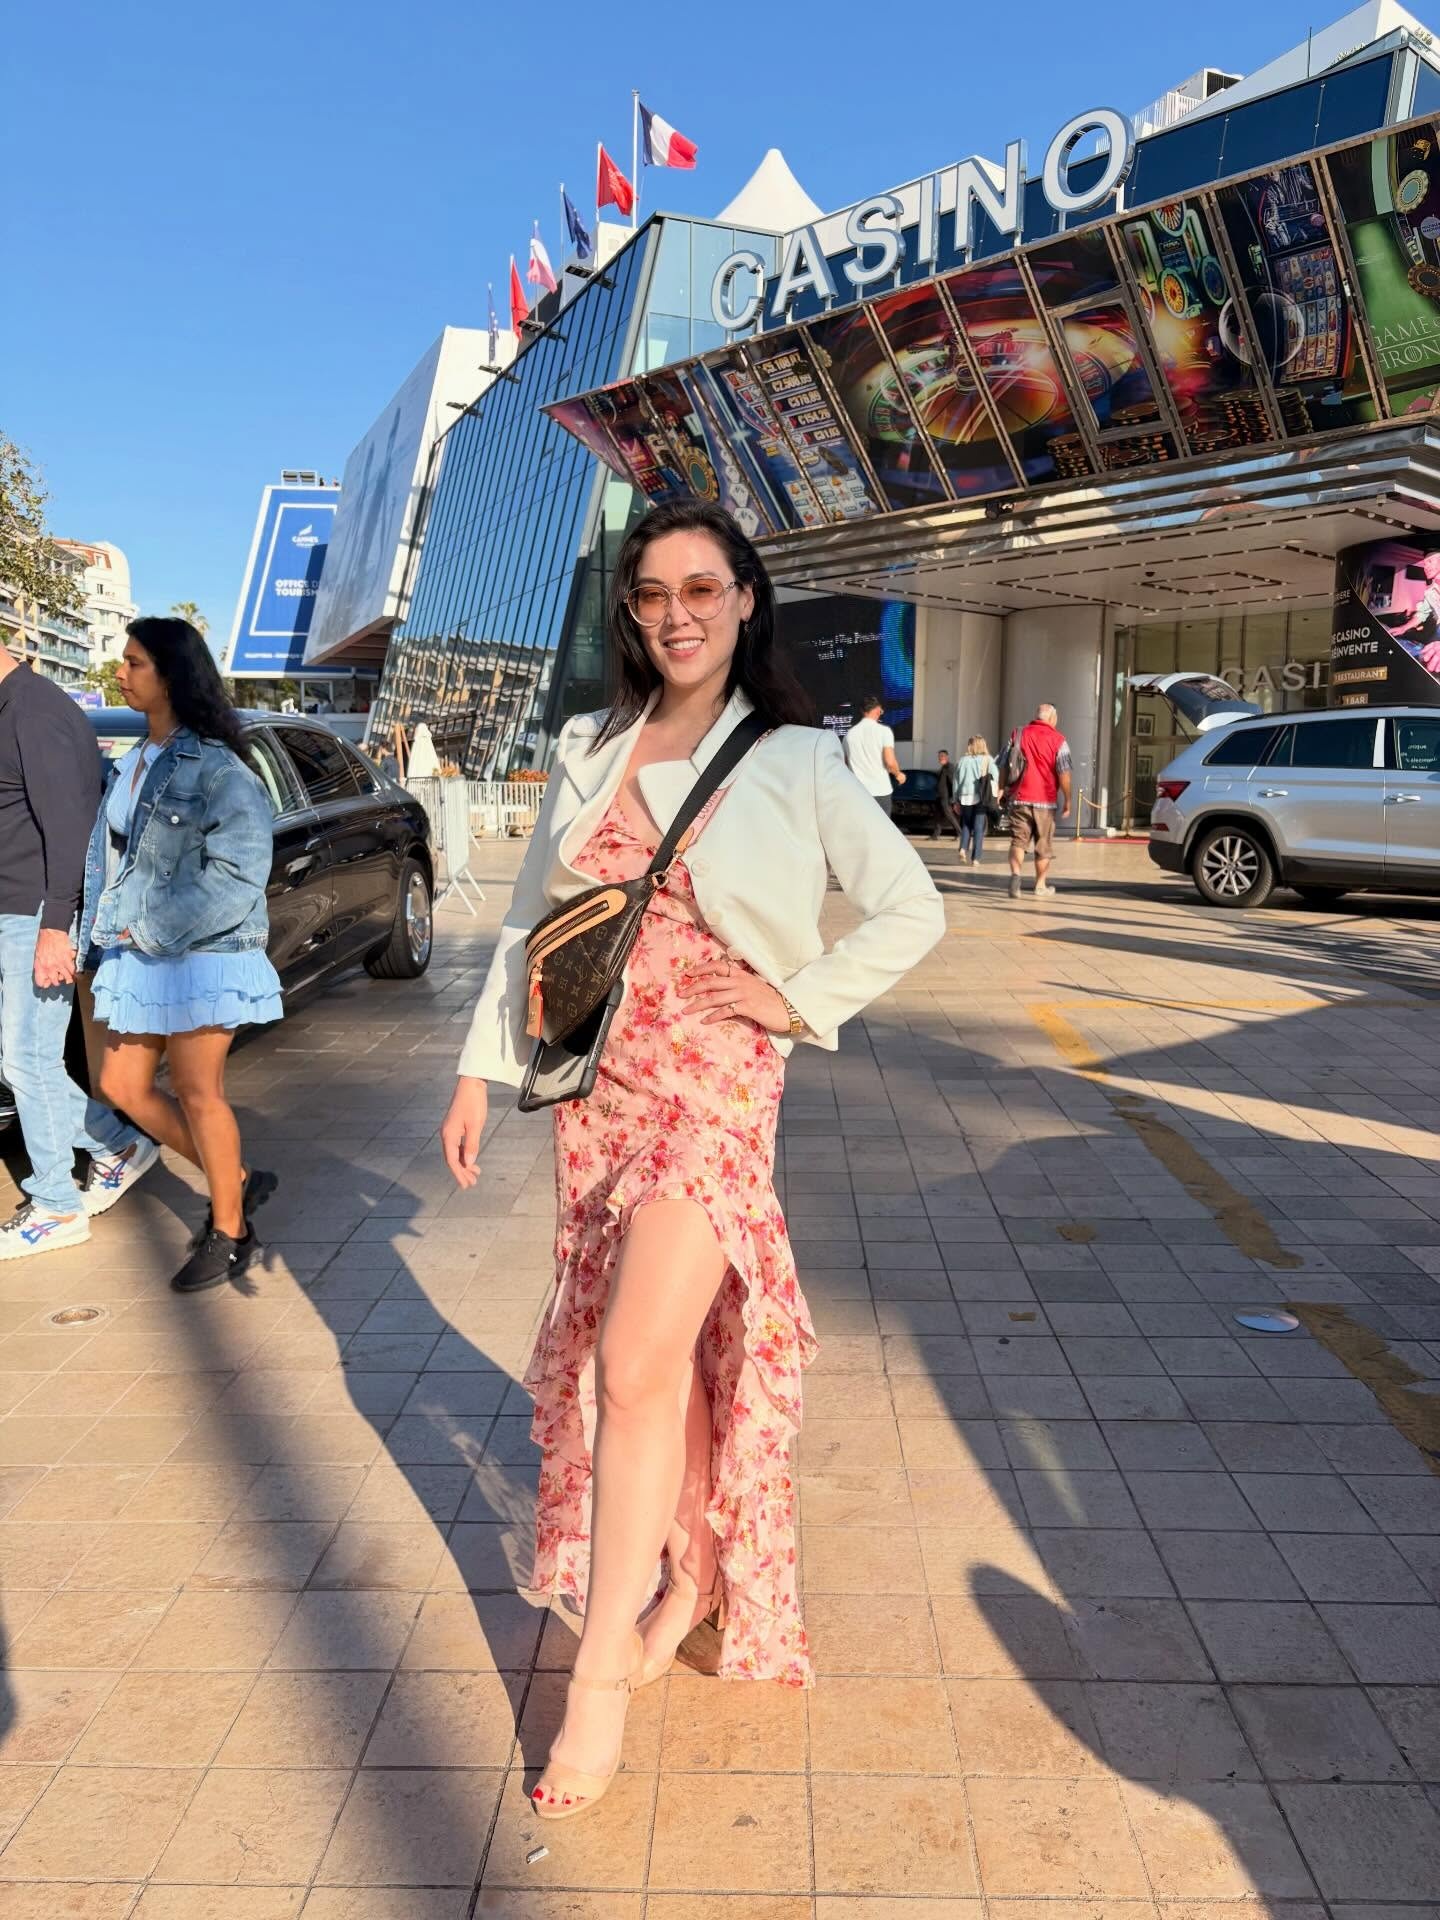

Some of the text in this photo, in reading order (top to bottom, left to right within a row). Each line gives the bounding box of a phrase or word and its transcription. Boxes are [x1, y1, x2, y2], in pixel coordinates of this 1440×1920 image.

[711, 106, 1135, 332] CASINO
[275, 579, 309, 588] OFFICE
[1336, 626, 1371, 643] CASINO
[1338, 669, 1385, 681] RESTAURANT
